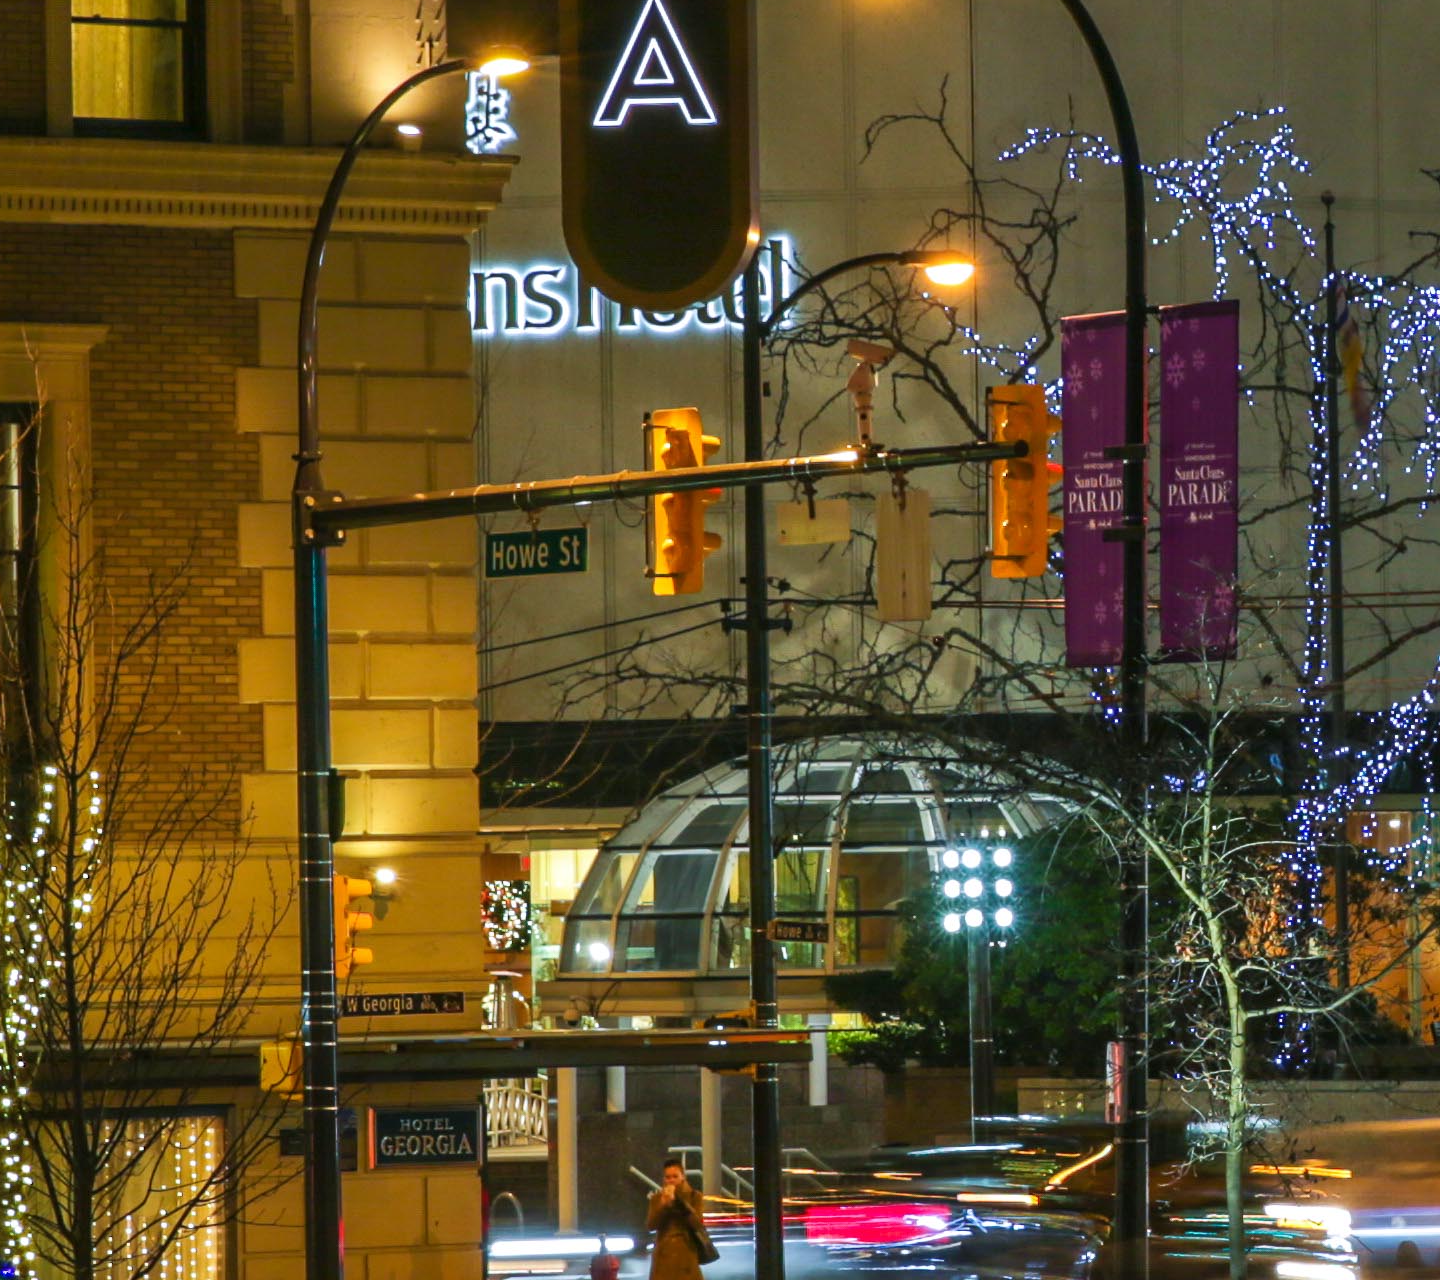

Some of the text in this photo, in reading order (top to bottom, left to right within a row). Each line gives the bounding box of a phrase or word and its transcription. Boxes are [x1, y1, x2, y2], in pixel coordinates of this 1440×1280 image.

[1074, 473, 1098, 489] Santa
[1174, 466, 1200, 481] Santa
[1068, 488, 1124, 514] PARAD
[1168, 479, 1233, 507] PARADE
[492, 535, 581, 571] Howe St
[347, 997, 358, 1013] W
[363, 993, 414, 1016] Georgia
[400, 1118, 455, 1132] HOTEL
[380, 1132, 474, 1157] GEORGIA
